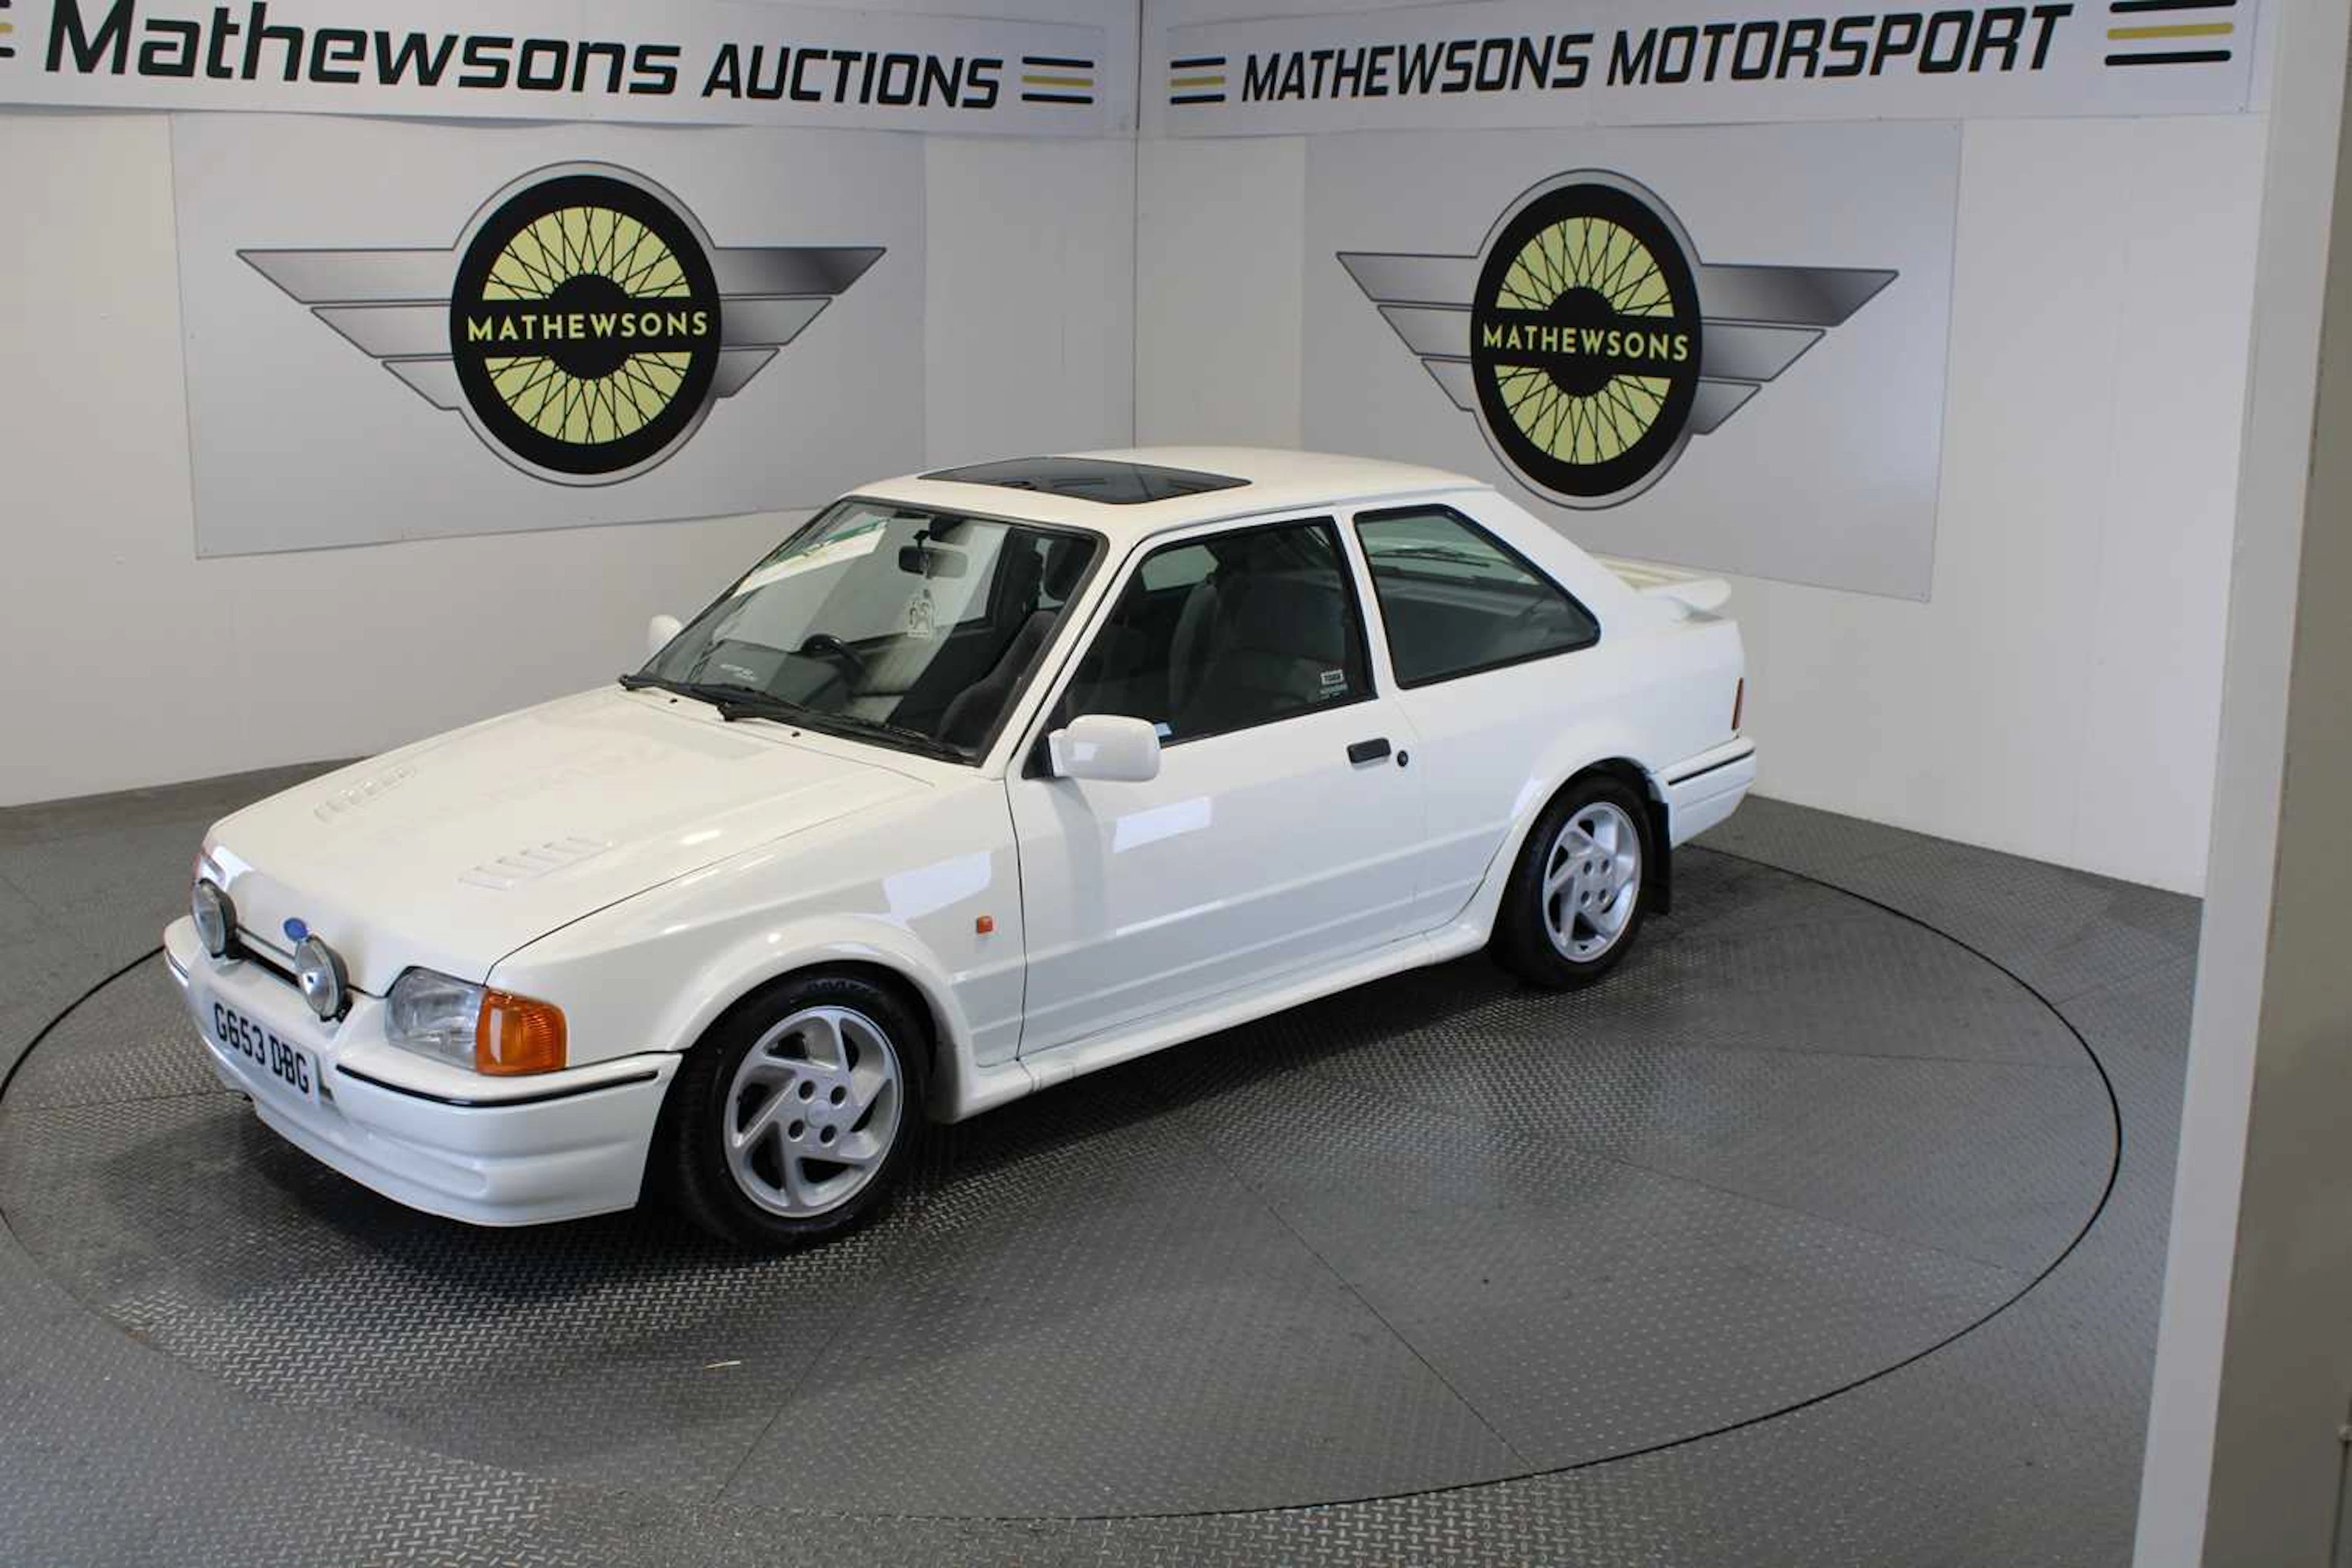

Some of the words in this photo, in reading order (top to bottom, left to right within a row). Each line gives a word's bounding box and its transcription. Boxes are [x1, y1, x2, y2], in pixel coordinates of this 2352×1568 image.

[45, 0, 681, 95] Mathewsons
[702, 43, 1004, 109] AUCTIONS
[1242, 33, 1594, 102] MATHEWSONS
[1607, 4, 2074, 86] MOTORSPORT
[467, 311, 707, 342] MATHEWSONS
[1482, 322, 1689, 361] MATHEWSONS
[213, 1001, 265, 1066] G653
[268, 1033, 309, 1094] DBG
